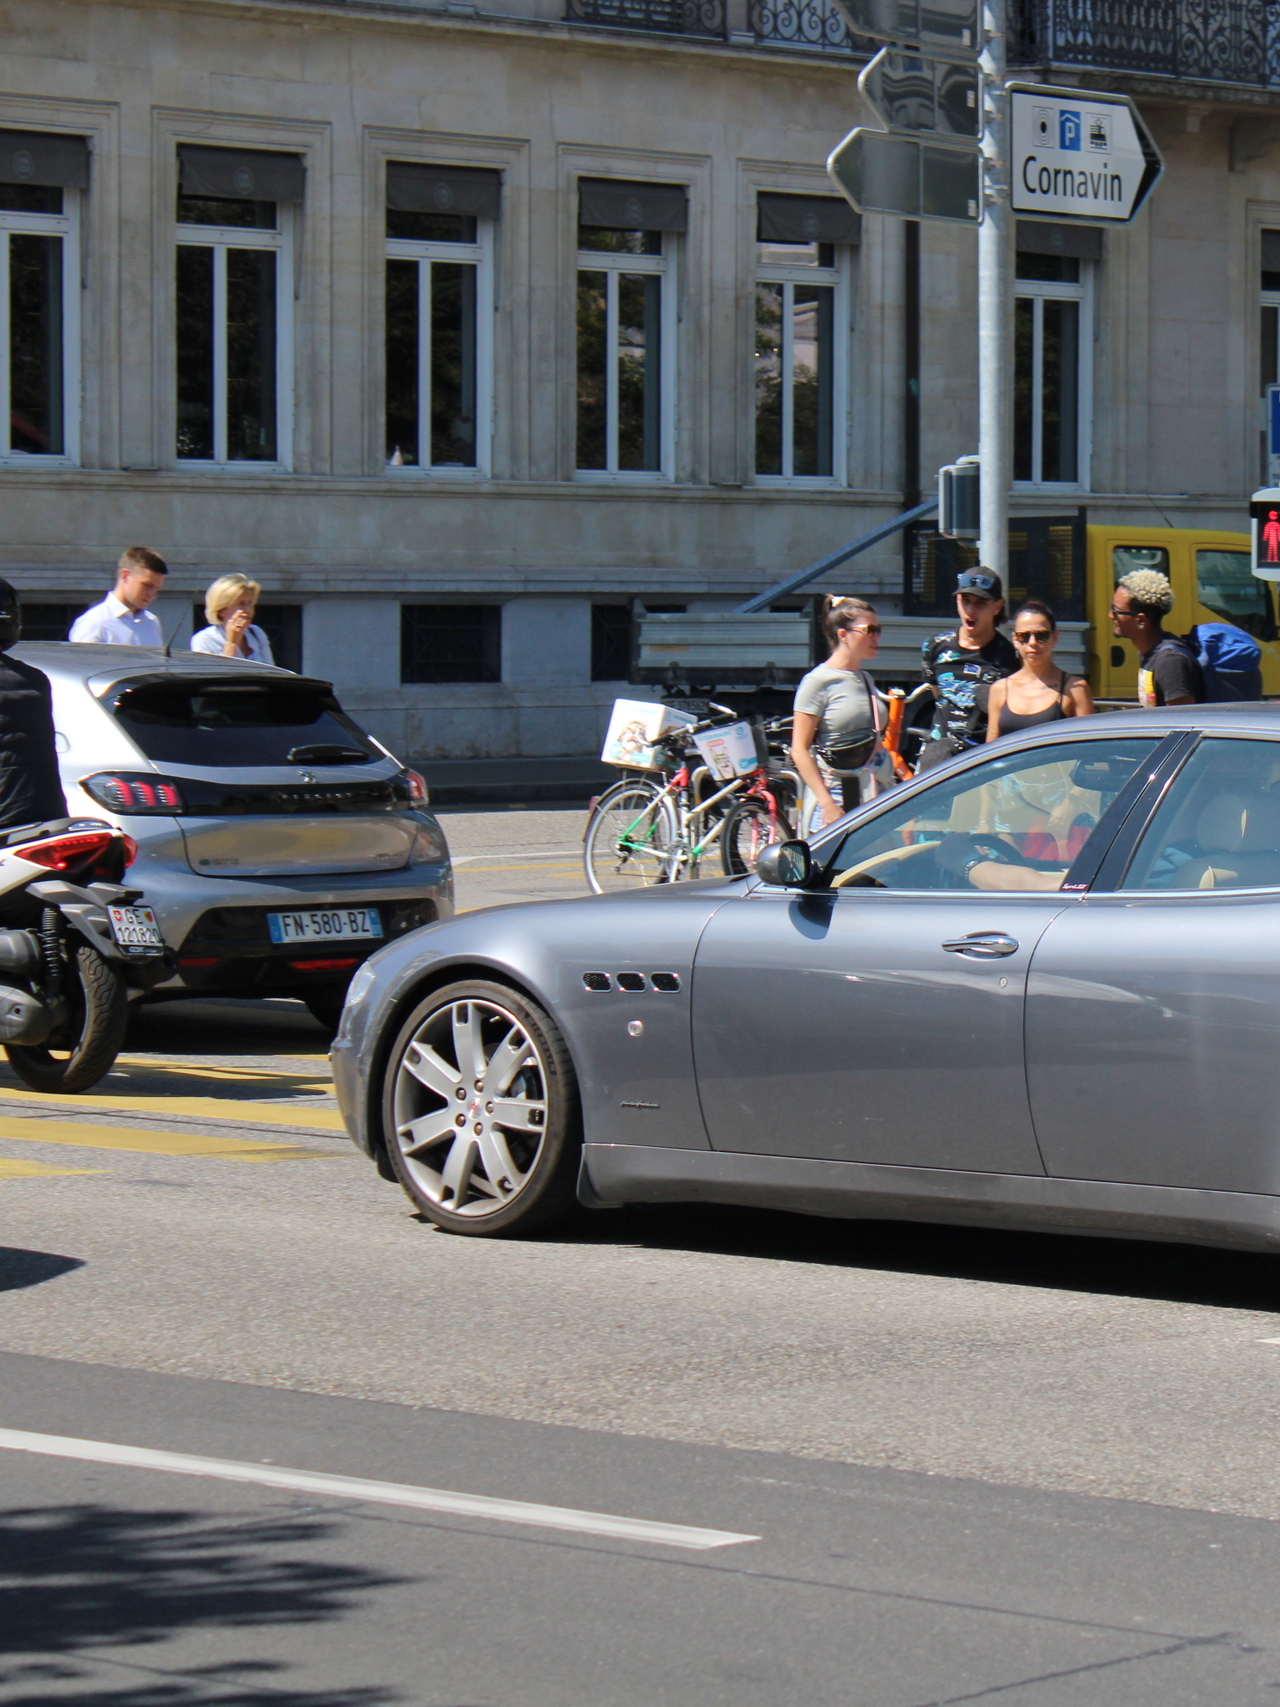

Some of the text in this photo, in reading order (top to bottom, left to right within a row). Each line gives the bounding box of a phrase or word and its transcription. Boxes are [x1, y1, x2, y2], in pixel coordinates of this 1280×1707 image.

[1023, 155, 1122, 202] Cornavin
[124, 908, 143, 924] GE
[281, 911, 370, 937] FN-580-BZ
